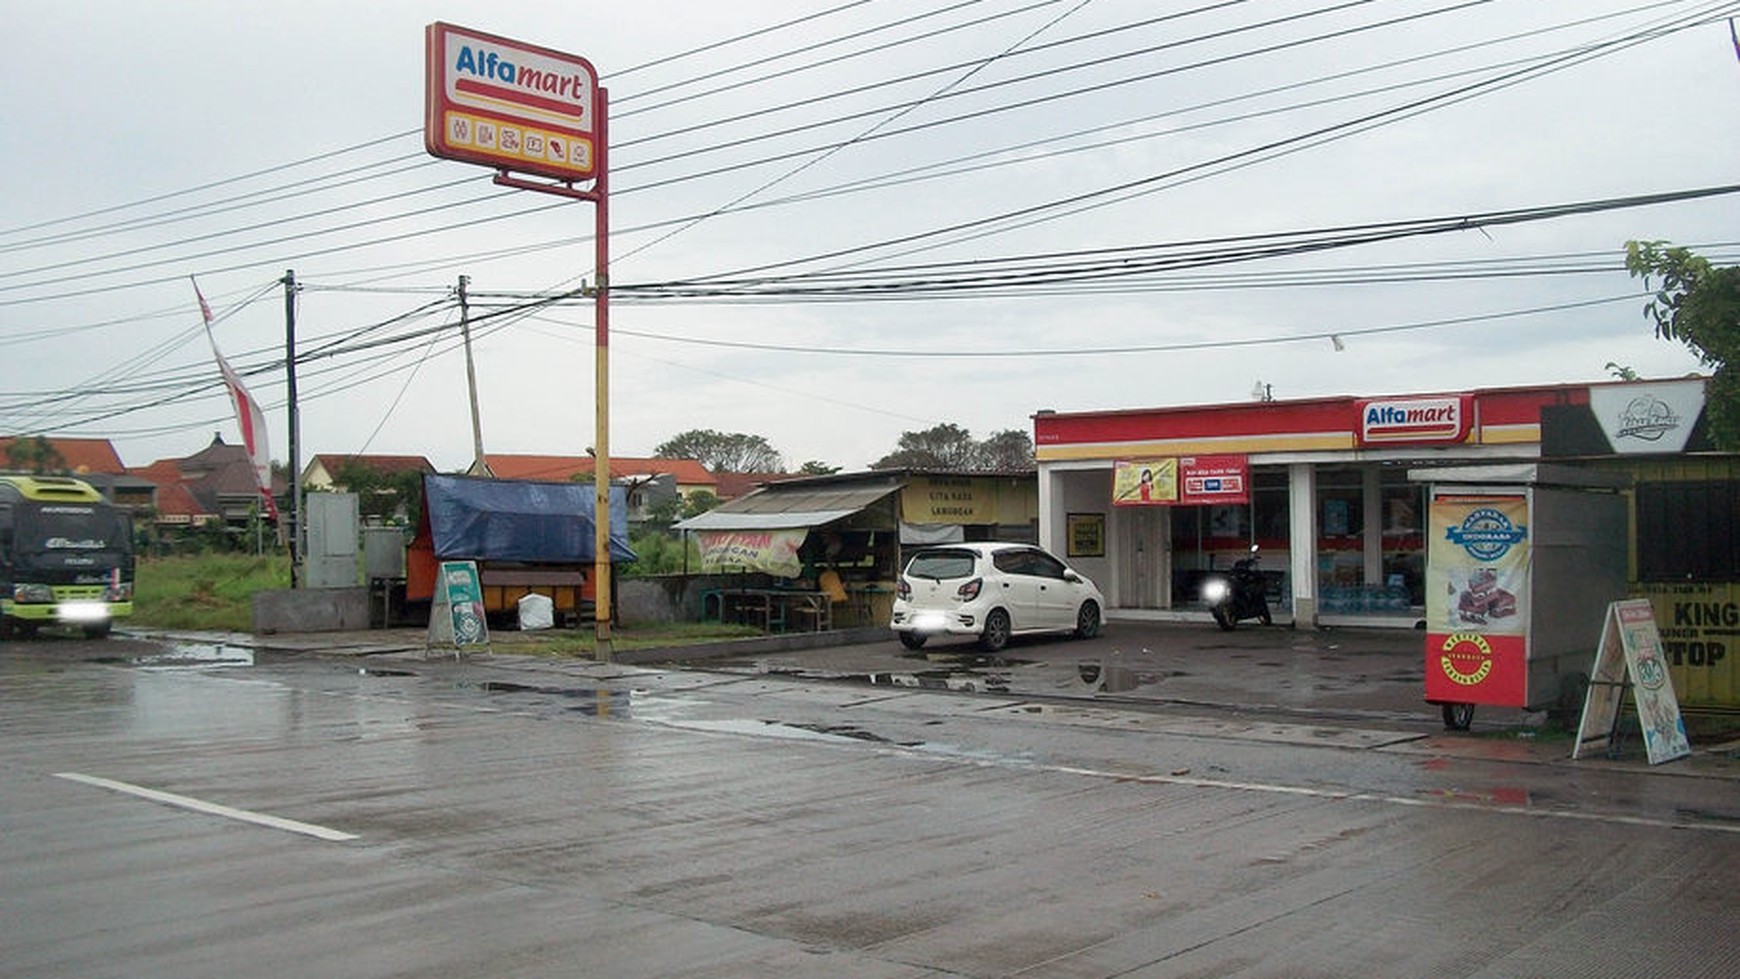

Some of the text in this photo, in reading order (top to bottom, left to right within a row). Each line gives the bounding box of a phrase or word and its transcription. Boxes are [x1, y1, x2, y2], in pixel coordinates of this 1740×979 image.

[456, 46, 583, 99] Alfamart
[1367, 405, 1455, 424] Alfamart
[1675, 602, 1739, 626] KING
